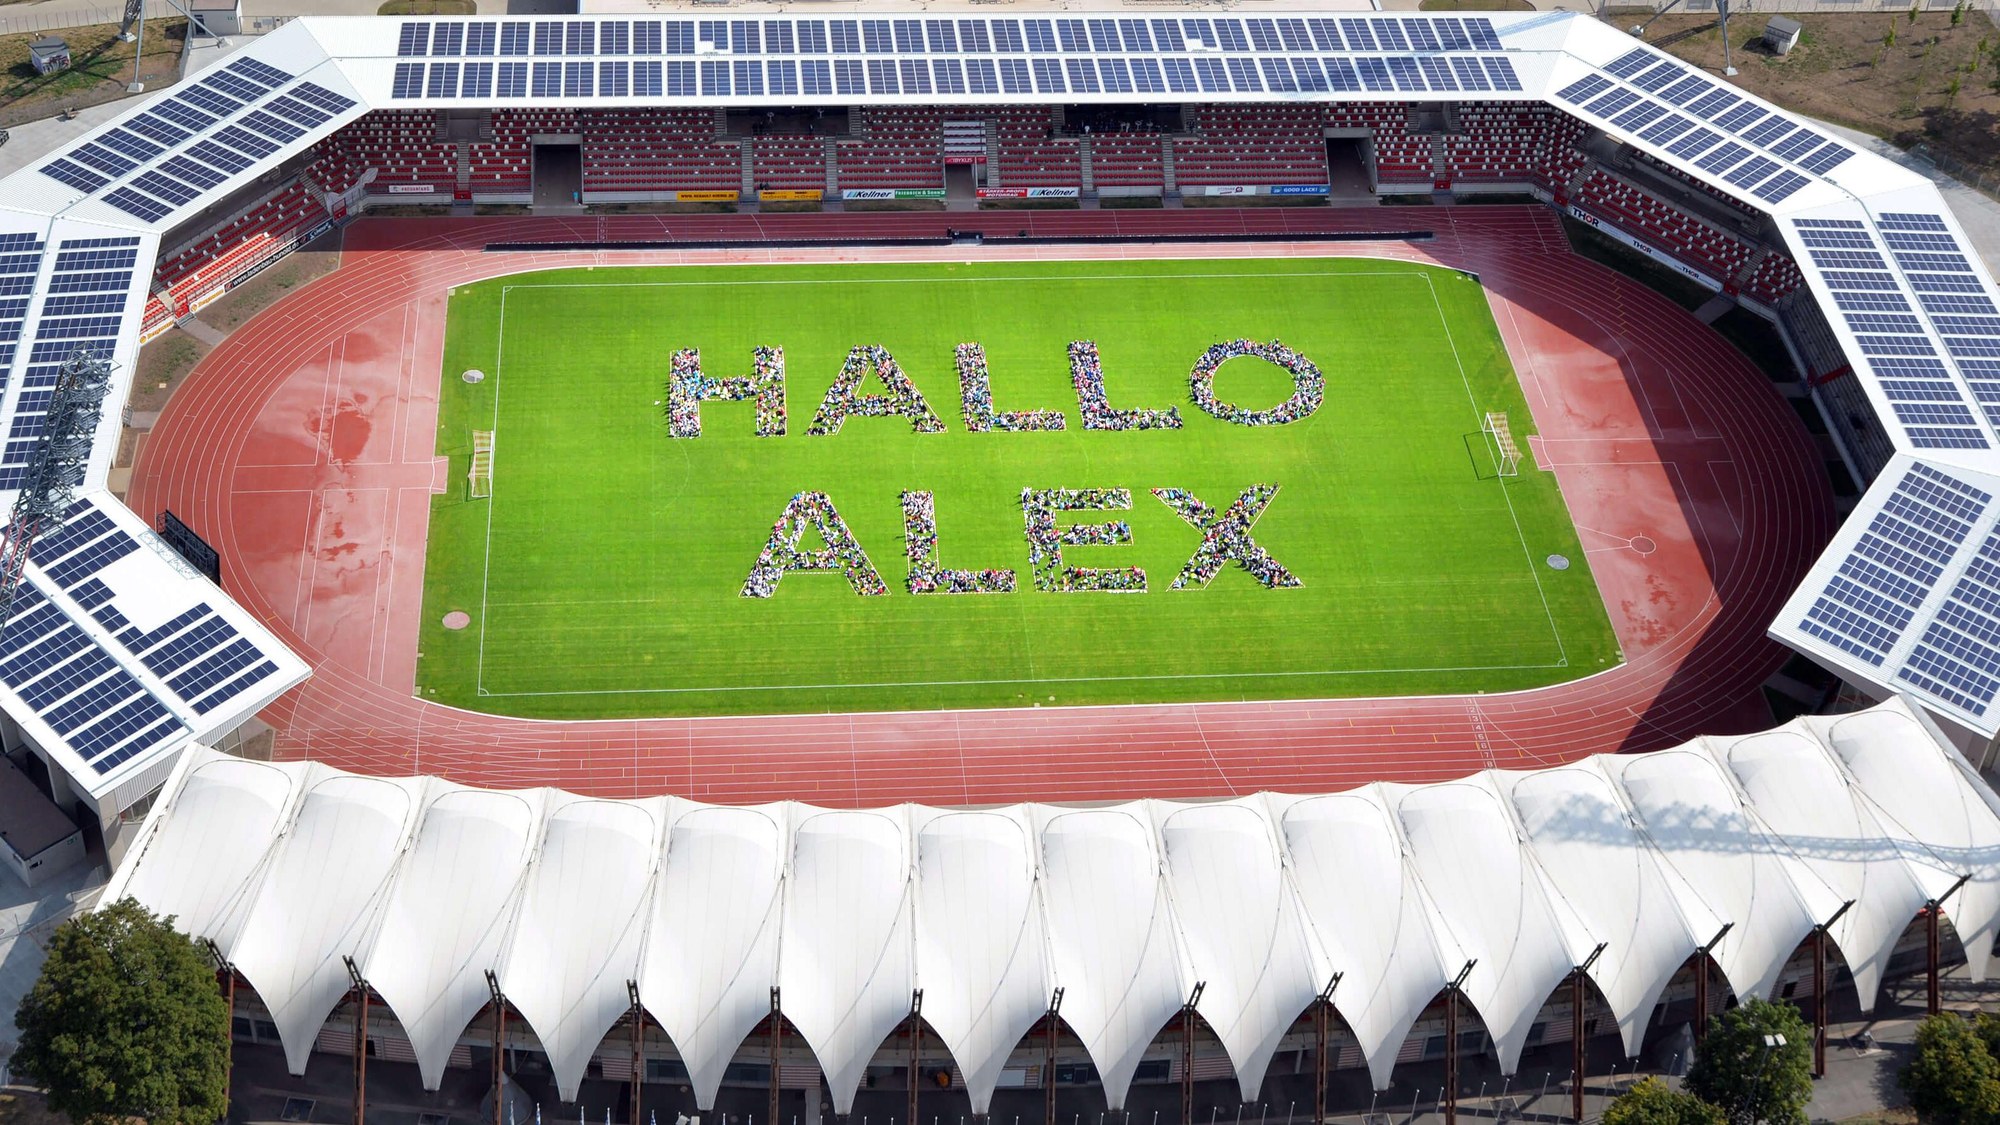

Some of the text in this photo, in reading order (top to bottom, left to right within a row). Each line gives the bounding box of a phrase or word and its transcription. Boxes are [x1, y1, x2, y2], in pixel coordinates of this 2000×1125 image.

[856, 190, 892, 198] Kellner
[1040, 188, 1076, 196] Kellner
[1573, 207, 1599, 227] THOR
[1633, 240, 1652, 254] THOR
[669, 338, 1326, 438] HALLO
[738, 482, 1306, 599] ALEX
